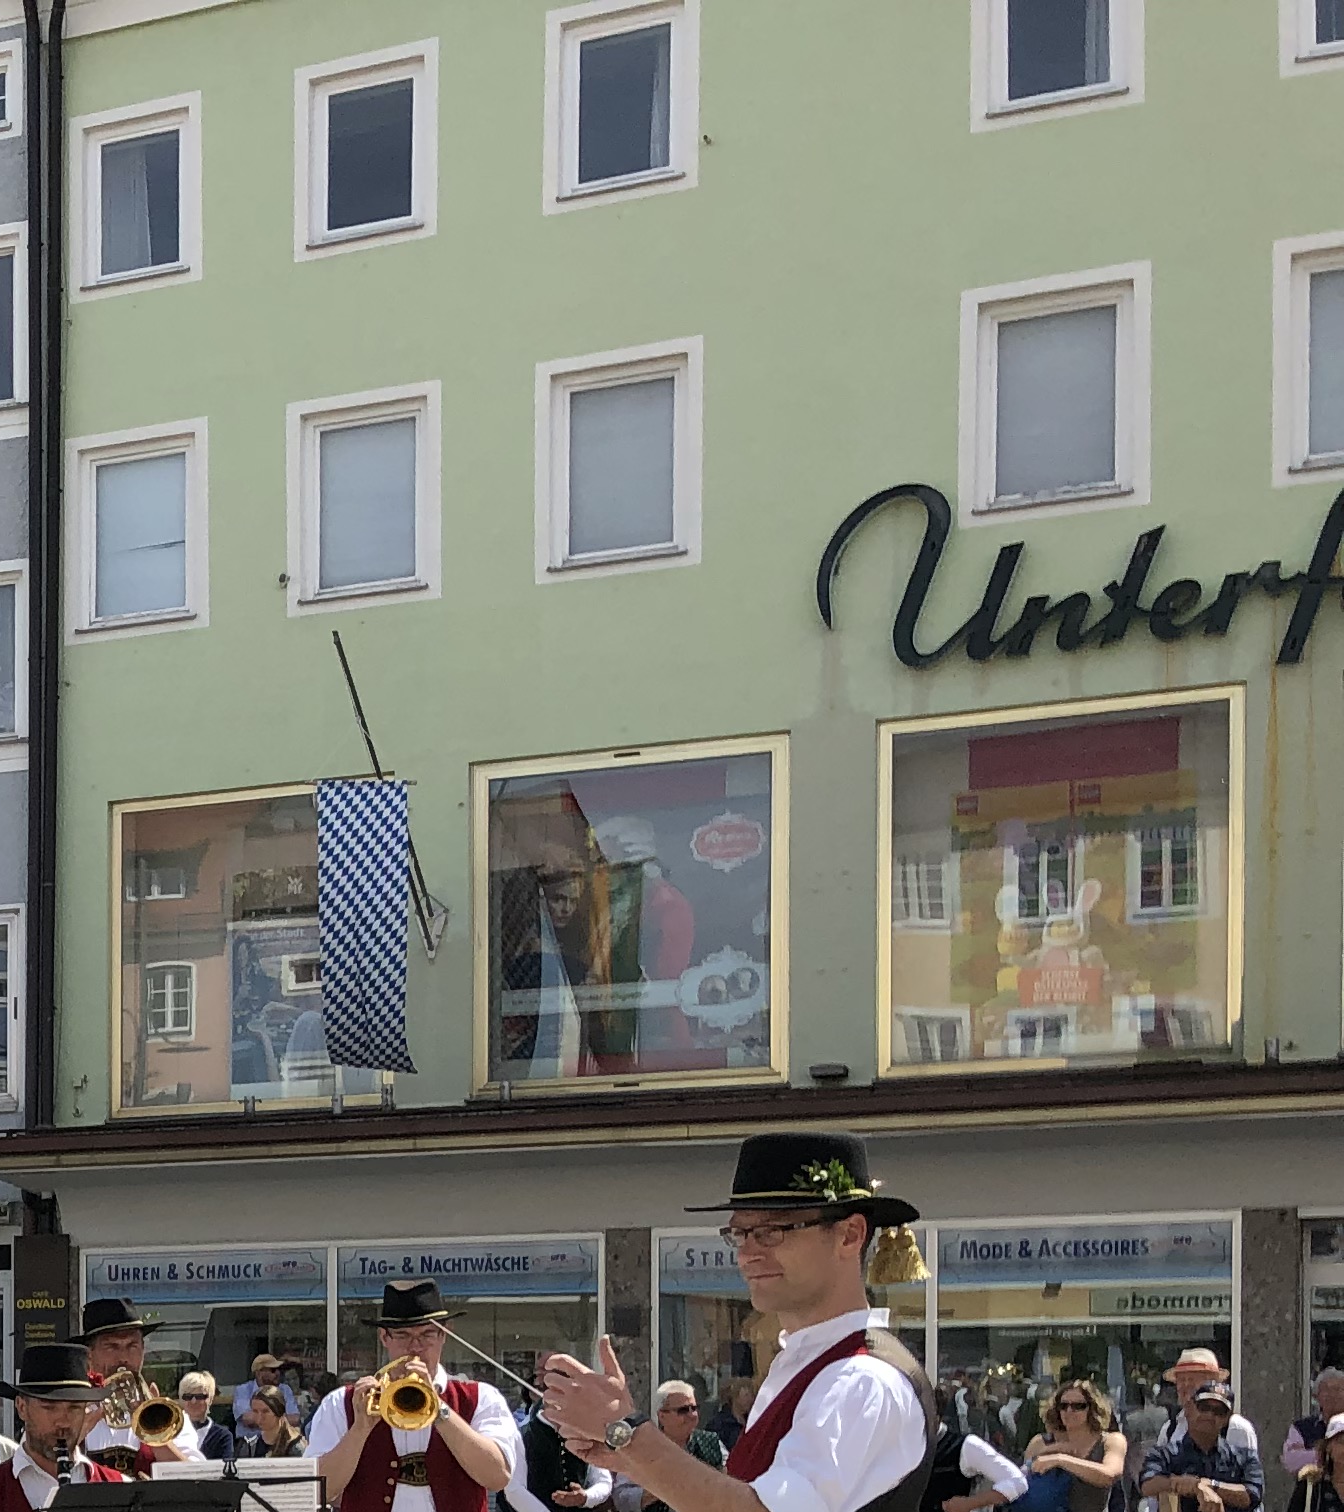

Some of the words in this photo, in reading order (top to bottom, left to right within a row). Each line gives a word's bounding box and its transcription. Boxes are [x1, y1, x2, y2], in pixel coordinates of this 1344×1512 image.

[815, 483, 1344, 668] Unterf
[1018, 1238, 1032, 1259] &
[107, 1263, 160, 1282] UHREN
[167, 1263, 179, 1281] &
[185, 1261, 262, 1280] SCHMUCK
[402, 1256, 414, 1273] &
[420, 1252, 530, 1274] NACHTWÄSCHE
[16, 1298, 66, 1310] OSWALD
